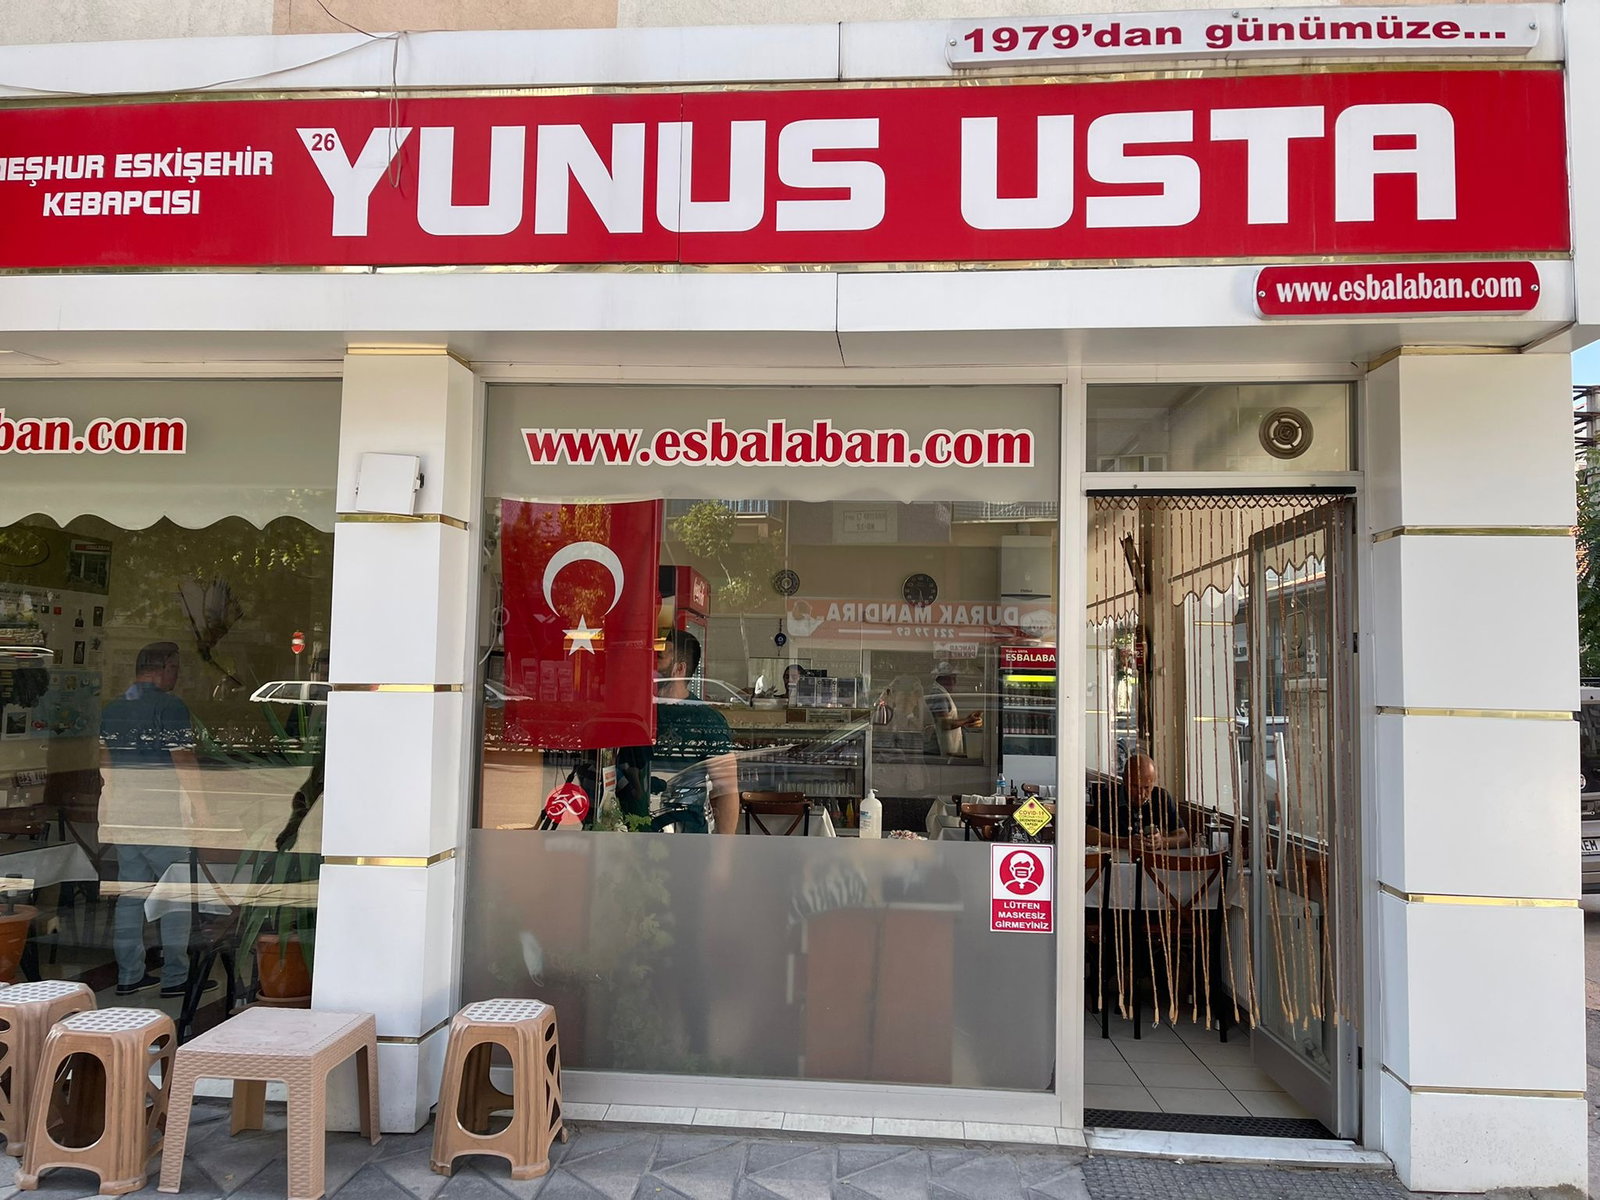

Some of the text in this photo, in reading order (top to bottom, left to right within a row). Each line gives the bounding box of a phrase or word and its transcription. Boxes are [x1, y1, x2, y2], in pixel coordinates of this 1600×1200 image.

[965, 15, 1507, 53] 1979'dan günümüze...
[310, 131, 337, 152] 26
[115, 145, 274, 184] ESKİŞEHİR
[296, 102, 1458, 237] YUNUS USTA
[42, 189, 201, 217] KEBAPCISI
[1276, 271, 1523, 303] www.esbalaban.com
[523, 419, 1035, 468] www.esbalaban.com
[998, 910, 1046, 920] MASKESİZ
[1003, 900, 1040, 910] LÜTFEN
[995, 919, 1049, 930] GİRMEYİNİZ
